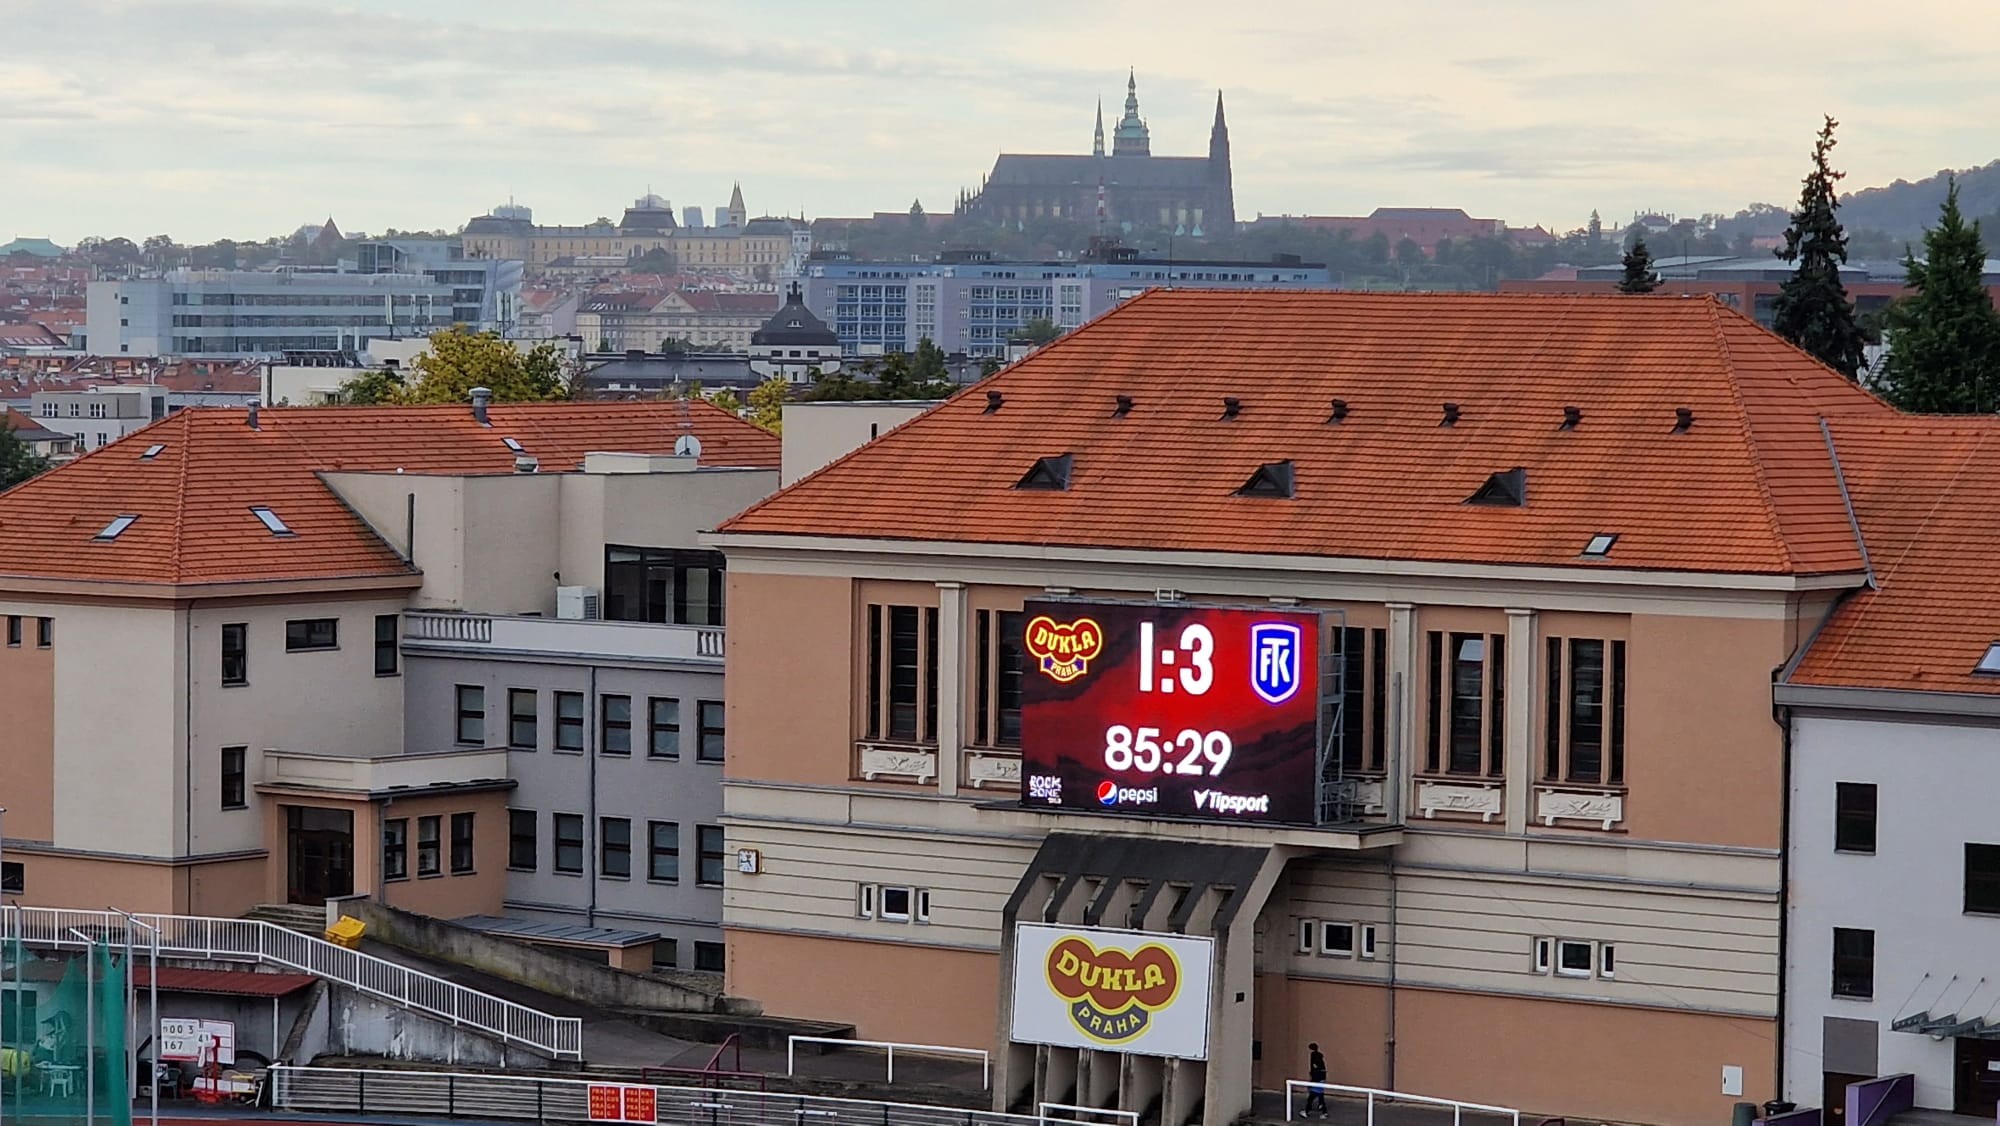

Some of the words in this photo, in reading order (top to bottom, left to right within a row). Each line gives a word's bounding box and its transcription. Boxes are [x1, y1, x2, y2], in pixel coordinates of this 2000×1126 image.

[1034, 627, 1096, 653] DUKLA
[1050, 662, 1079, 677] PRAHA
[1140, 622, 1214, 695] 1:3
[1105, 725, 1232, 776] 85:29
[1029, 775, 1062, 789] ROCK
[1029, 787, 1062, 797] ZONE
[1118, 787, 1158, 805] pepsi
[1209, 791, 1269, 814] Tipsport
[1056, 949, 1166, 991] DUKLA
[1078, 1006, 1141, 1034] PRAHA
[164, 1041, 183, 1050] 167
